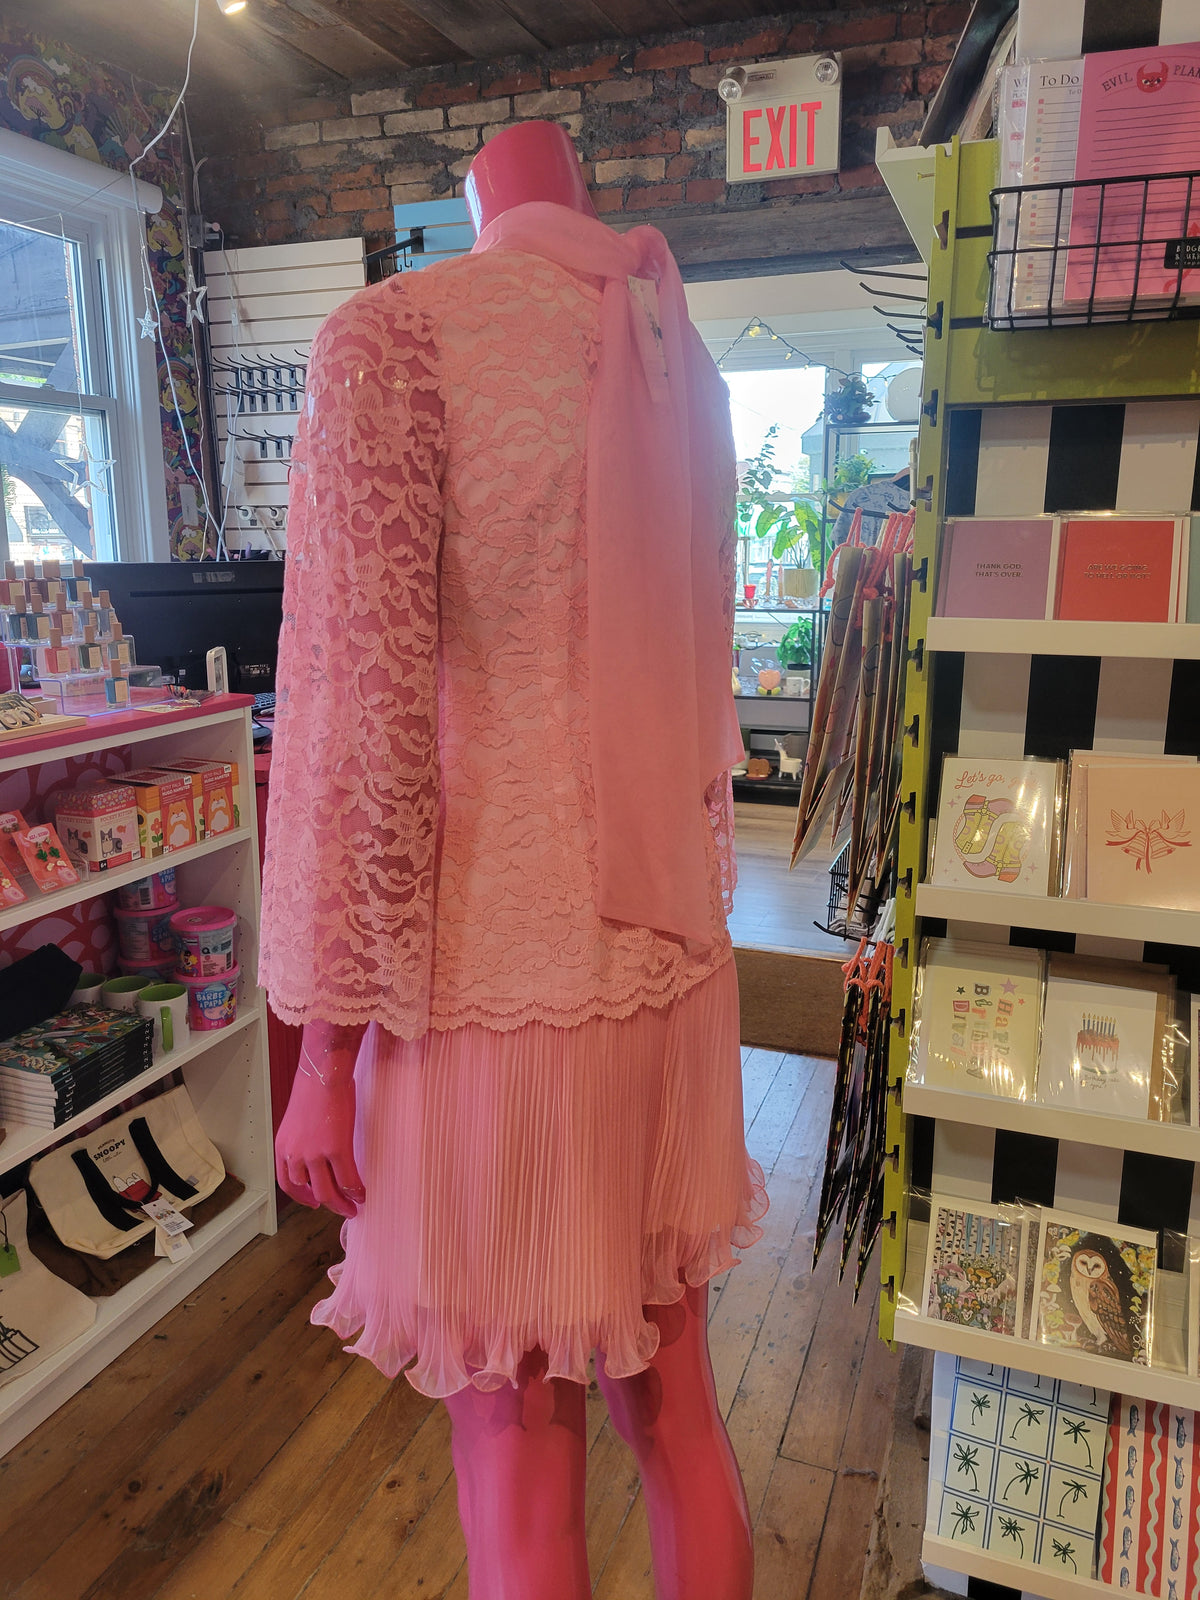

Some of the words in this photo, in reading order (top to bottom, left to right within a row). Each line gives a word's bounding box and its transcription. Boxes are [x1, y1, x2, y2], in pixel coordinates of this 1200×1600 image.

[1040, 75, 1057, 87] To
[1061, 73, 1080, 86] Do
[1102, 72, 1133, 92] EVIL
[743, 101, 822, 173] EXIT
[1096, 571, 1115, 579] HELL
[954, 770, 986, 789] Let's
[196, 991, 223, 1002] BARBE
[203, 998, 222, 1009] PAPA
[93, 1138, 126, 1160] SNOOPY
